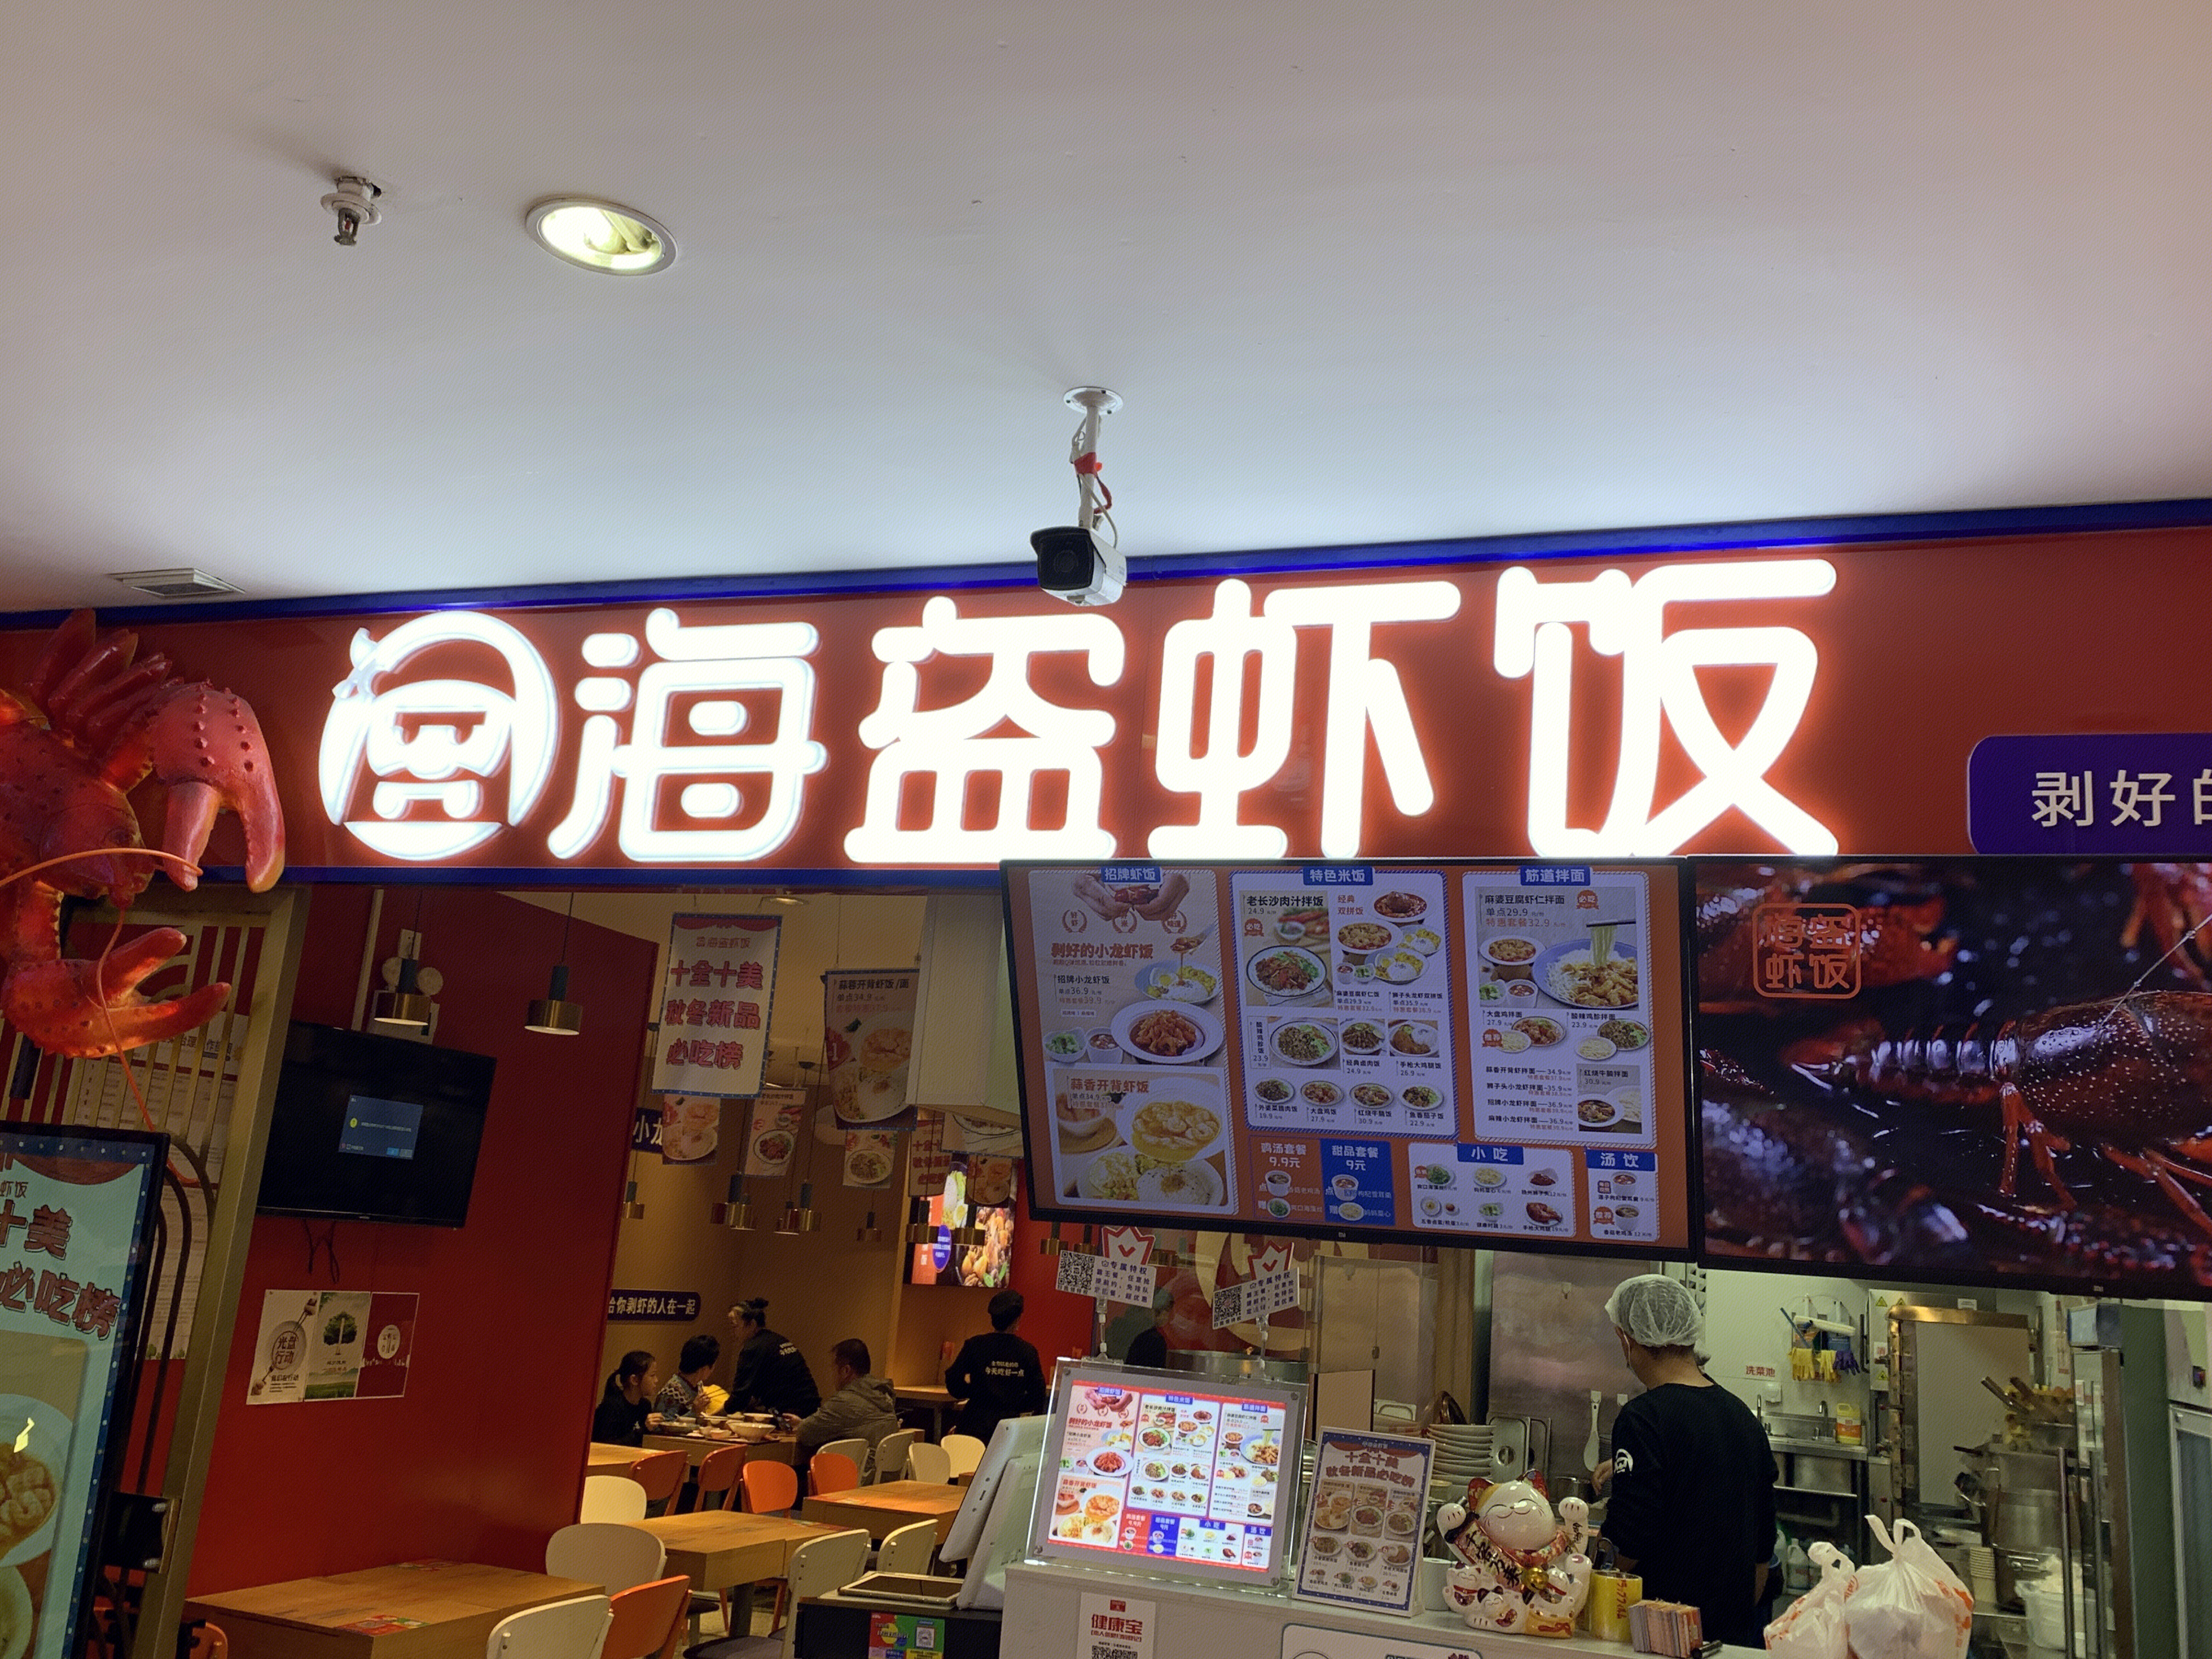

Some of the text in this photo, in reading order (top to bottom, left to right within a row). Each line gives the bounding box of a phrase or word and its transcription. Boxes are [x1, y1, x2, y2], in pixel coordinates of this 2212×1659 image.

[549, 558, 1840, 861] 海盗虾饭
[1104, 867, 1156, 881] 招牌虾饭
[1310, 869, 1365, 882] 特色米饭
[1525, 869, 1585, 882] 筋道拌面
[1246, 896, 1323, 907] 老长沙肉汁拌饭
[1338, 895, 1355, 904] 经典
[1485, 894, 1565, 904] 麻婆豆腐虾仁拌面
[1338, 907, 1363, 915] 双拼饭
[1486, 908, 1528, 917] 单点29.9
[1486, 918, 1550, 927] 特惠套餐32.9
[1051, 943, 1154, 958] 剥好的小龙虾饭
[670, 960, 763, 990] 十全十美
[1765, 953, 1850, 990] 虾饭
[1057, 975, 1110, 985] 招牌小龙虾饭
[665, 998, 760, 1030] 秋冬新品
[667, 1038, 743, 1069] 必吃榜
[1400, 1061, 1442, 1069] 手枪大鸡腿饭
[1070, 1078, 1149, 1093] 蒜香开背虾饭
[1261, 1143, 1306, 1155] 鸡汤套餐
[1331, 1146, 1379, 1159] 甜品套餐
[1269, 1157, 1301, 1168] 9.9元
[1346, 1160, 1366, 1171] 9元
[1110, 1261, 1147, 1275] 专属特权
[0, 1262, 121, 1340] 必吃榜
[275, 1350, 294, 1364] 行动
[1745, 1365, 1775, 1377] 洗菜池
[1345, 1452, 1399, 1469] 十全十美
[1091, 1614, 1143, 1635] 健康宝
